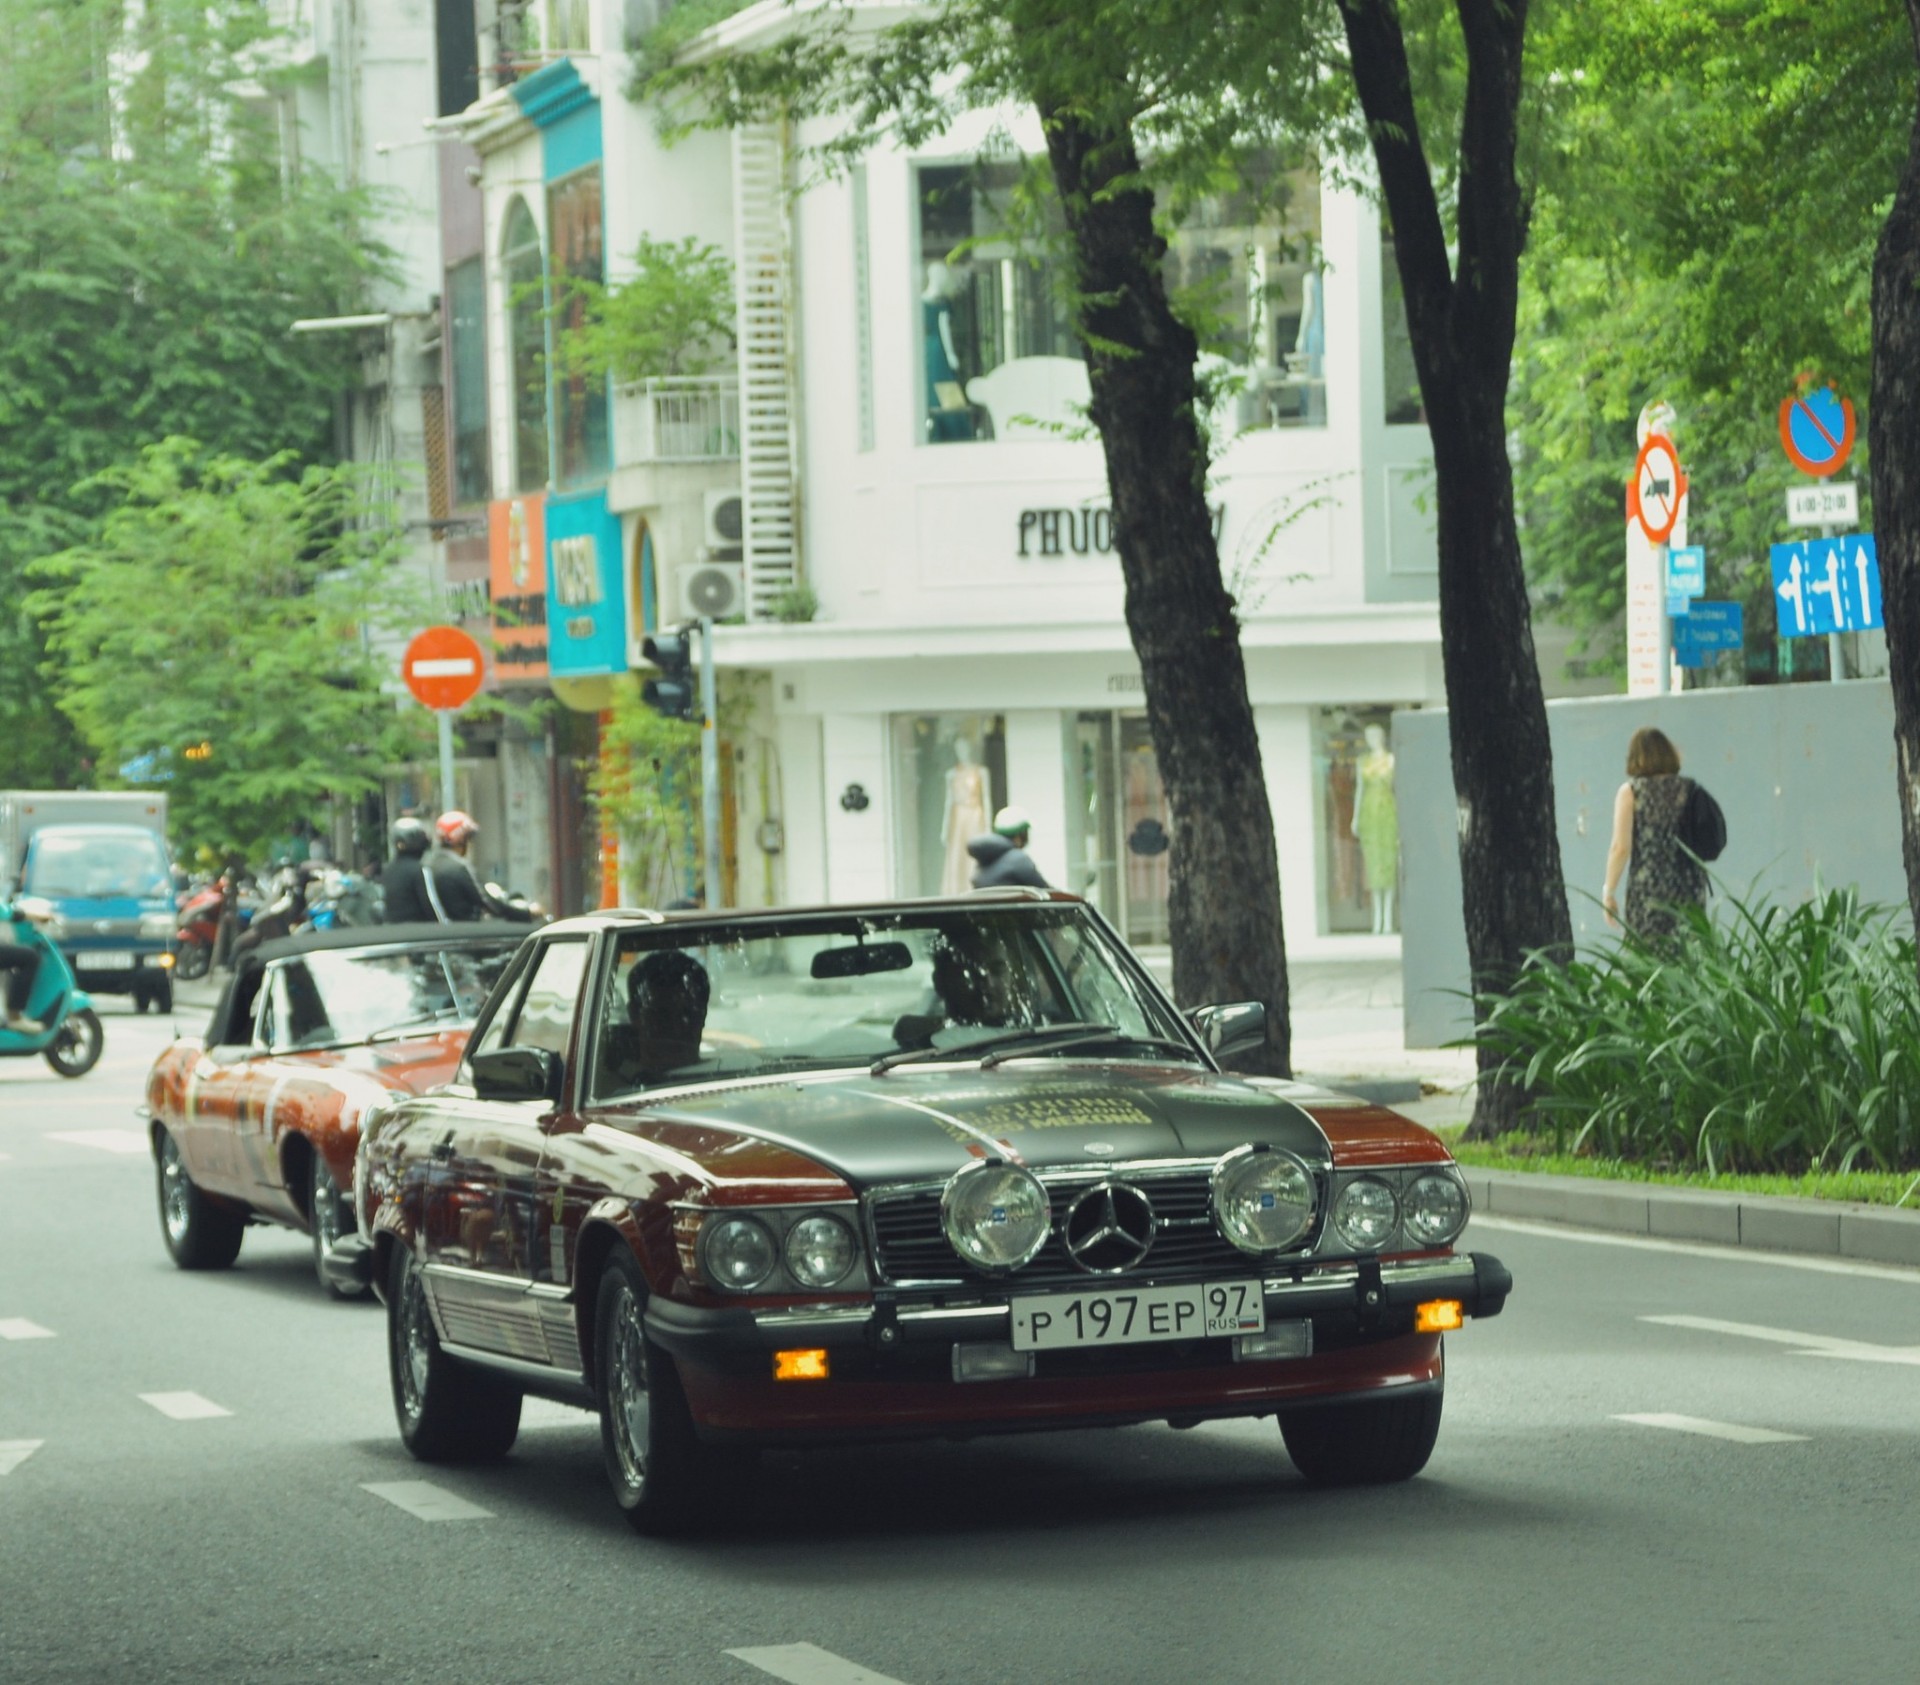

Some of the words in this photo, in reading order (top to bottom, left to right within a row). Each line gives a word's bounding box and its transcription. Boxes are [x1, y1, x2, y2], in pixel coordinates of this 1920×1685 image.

[1064, 1295, 1138, 1340] 197
[1209, 1285, 1247, 1318] 97
[1208, 1317, 1237, 1331] RUS
